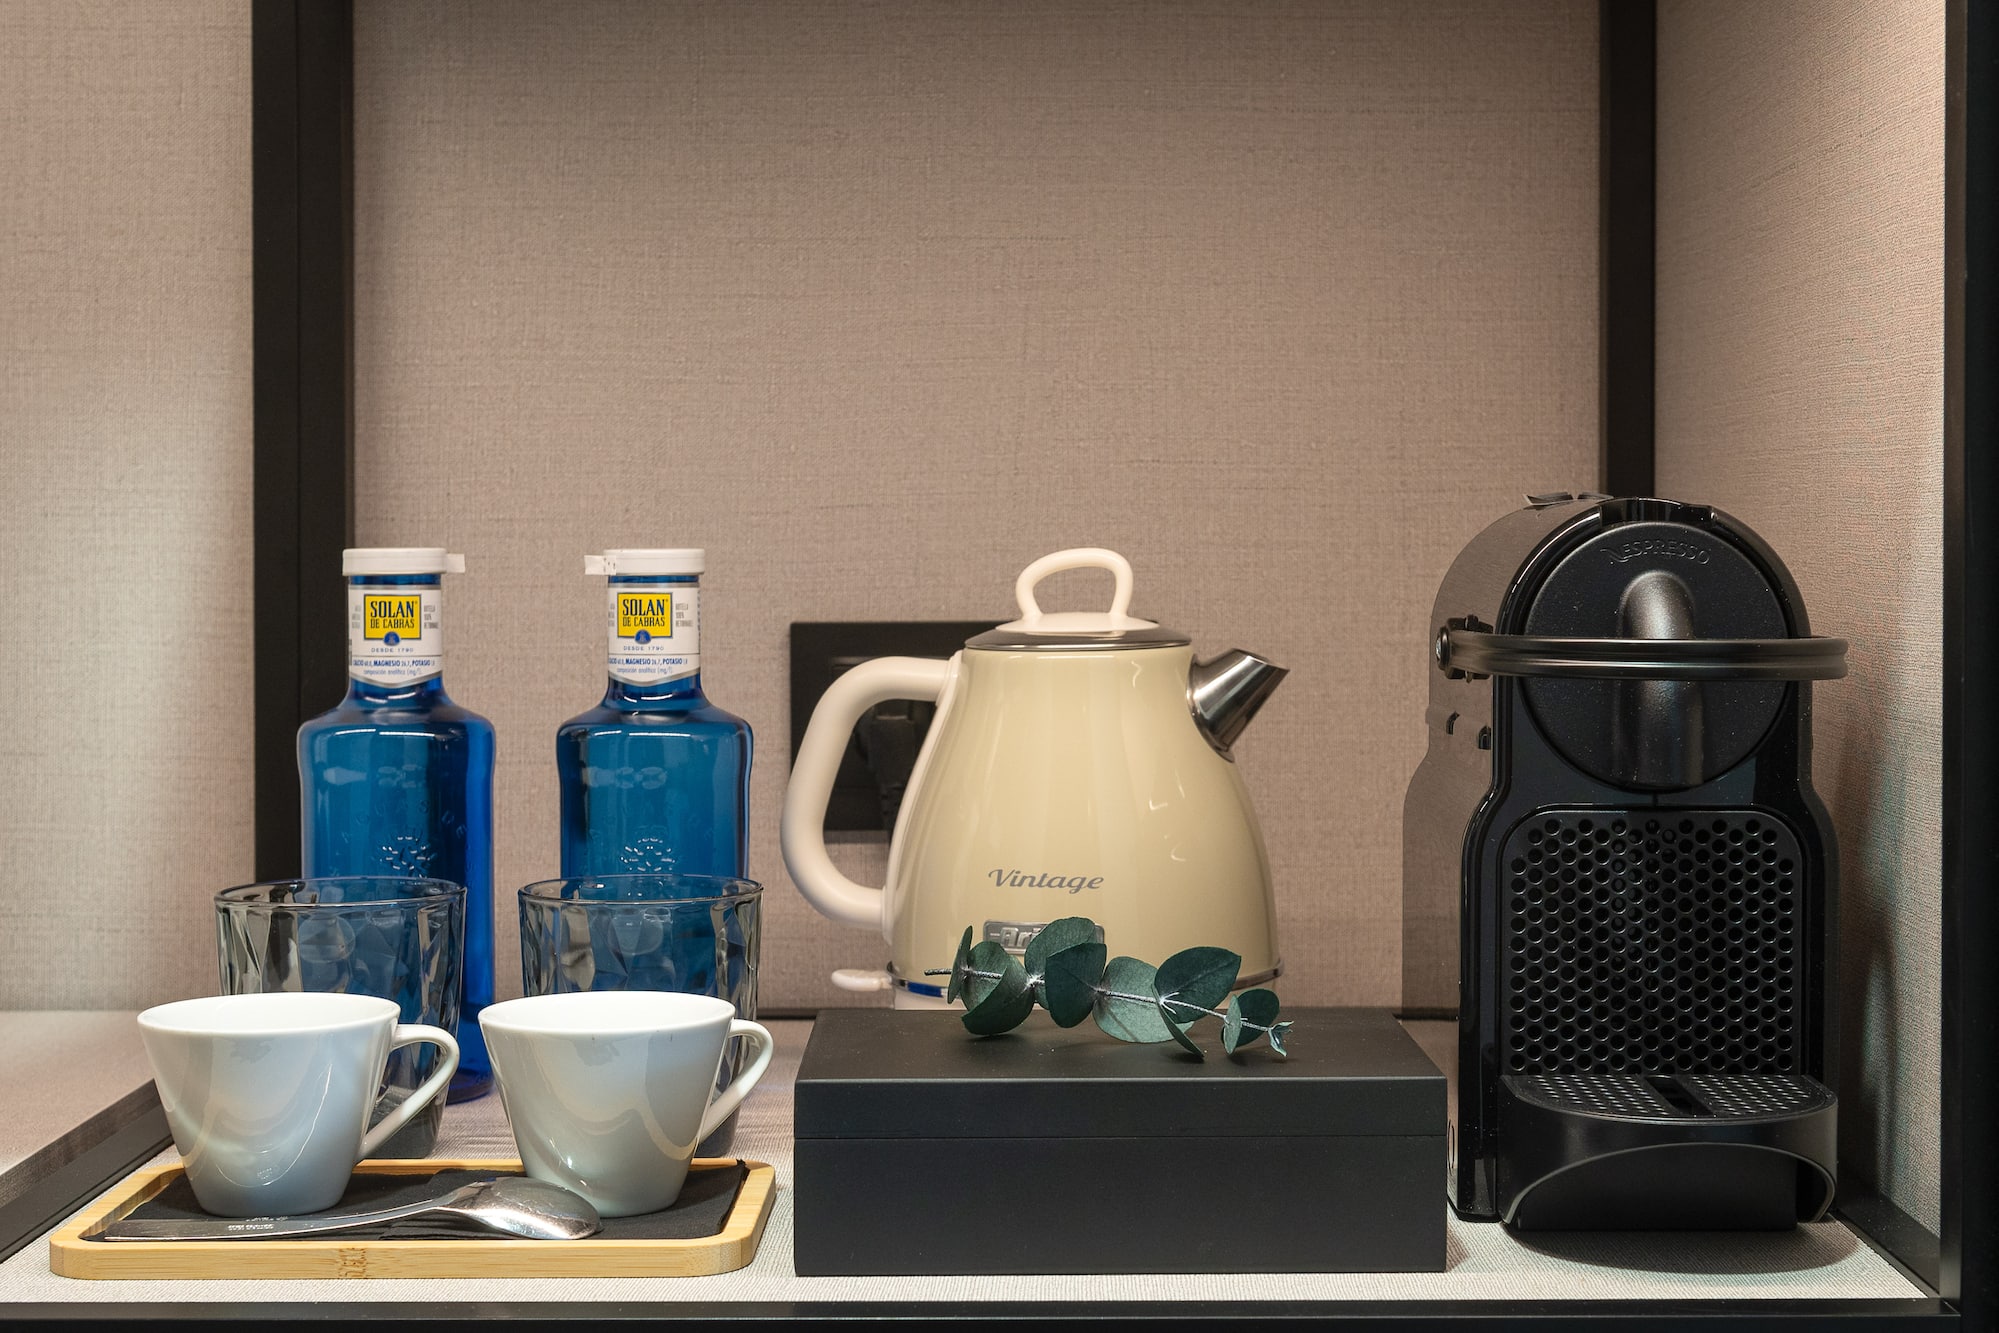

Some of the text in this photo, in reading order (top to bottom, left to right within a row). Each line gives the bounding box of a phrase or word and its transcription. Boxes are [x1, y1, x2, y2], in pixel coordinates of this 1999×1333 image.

[1599, 539, 1711, 565] NESPRESSO
[370, 600, 415, 618] SOLAN
[622, 598, 666, 616] SOLAN
[370, 619, 380, 628] DE
[383, 618, 415, 629] CABRAS
[622, 617, 632, 626] DE
[634, 617, 666, 627] CABRAS
[988, 868, 1104, 894] Vintage
[1000, 926, 1043, 948] Ari
